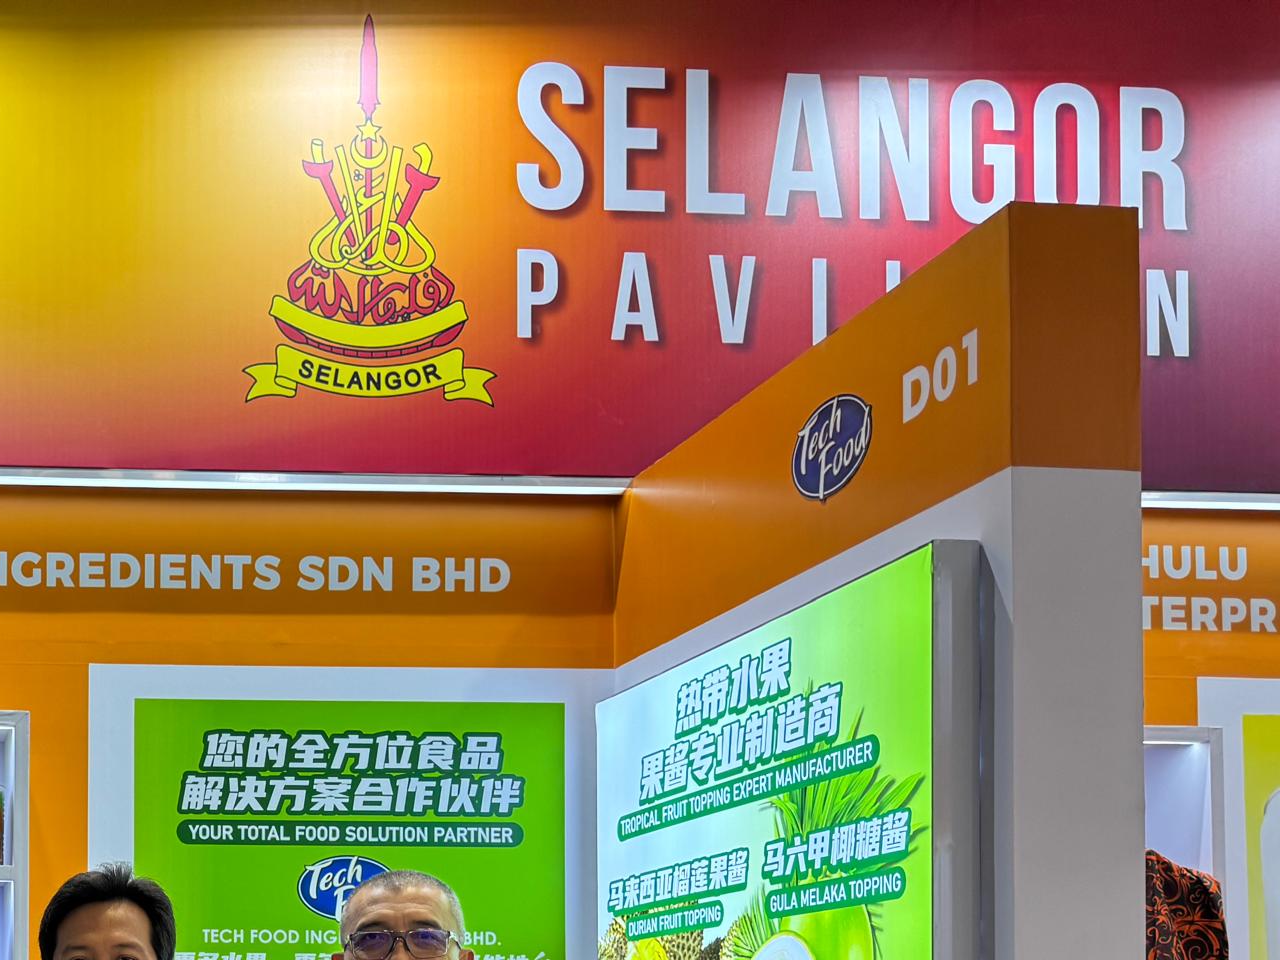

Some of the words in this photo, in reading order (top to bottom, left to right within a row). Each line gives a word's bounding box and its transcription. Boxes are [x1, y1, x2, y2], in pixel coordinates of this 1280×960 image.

[517, 62, 1187, 231] SELANGOR
[517, 248, 1190, 357] PAVIN
[298, 359, 442, 391] SELANGOR
[902, 328, 978, 424] D01
[798, 397, 841, 475] Tech
[818, 406, 871, 499] Food
[297, 556, 393, 591] SDN
[412, 557, 511, 592] BHD
[675, 638, 791, 734] 热带水果
[202, 733, 500, 770] 您的全方位食品
[640, 683, 841, 800] 果酱专业制造商
[181, 776, 522, 813] 解决方案合作伙伴
[621, 812, 660, 836] TROPICAL
[662, 801, 688, 823] FRUIT
[690, 787, 730, 812] TOPPING
[733, 773, 773, 800] EXPERT
[776, 741, 873, 790] MANUFACTURER
[188, 825, 233, 841] YOUR
[237, 826, 290, 841] TOTAL
[295, 826, 340, 842] FOOD
[345, 827, 428, 842] SOLUTION
[433, 827, 513, 843] PARTNER
[764, 812, 908, 877] 马六甲椰糖酱
[305, 856, 362, 899] Tech
[608, 850, 749, 911] 马来西亚榴莲果酱
[770, 892, 797, 913] GULA
[800, 884, 846, 908] MELAKA
[849, 873, 902, 899] TOPPING
[202, 929, 244, 944] TECH
[250, 929, 300, 945] FOOD
[464, 931, 502, 946] BHD.
[628, 917, 657, 937] DURIAN
[659, 913, 682, 933] FRUIT
[683, 906, 721, 929] TOPPING
